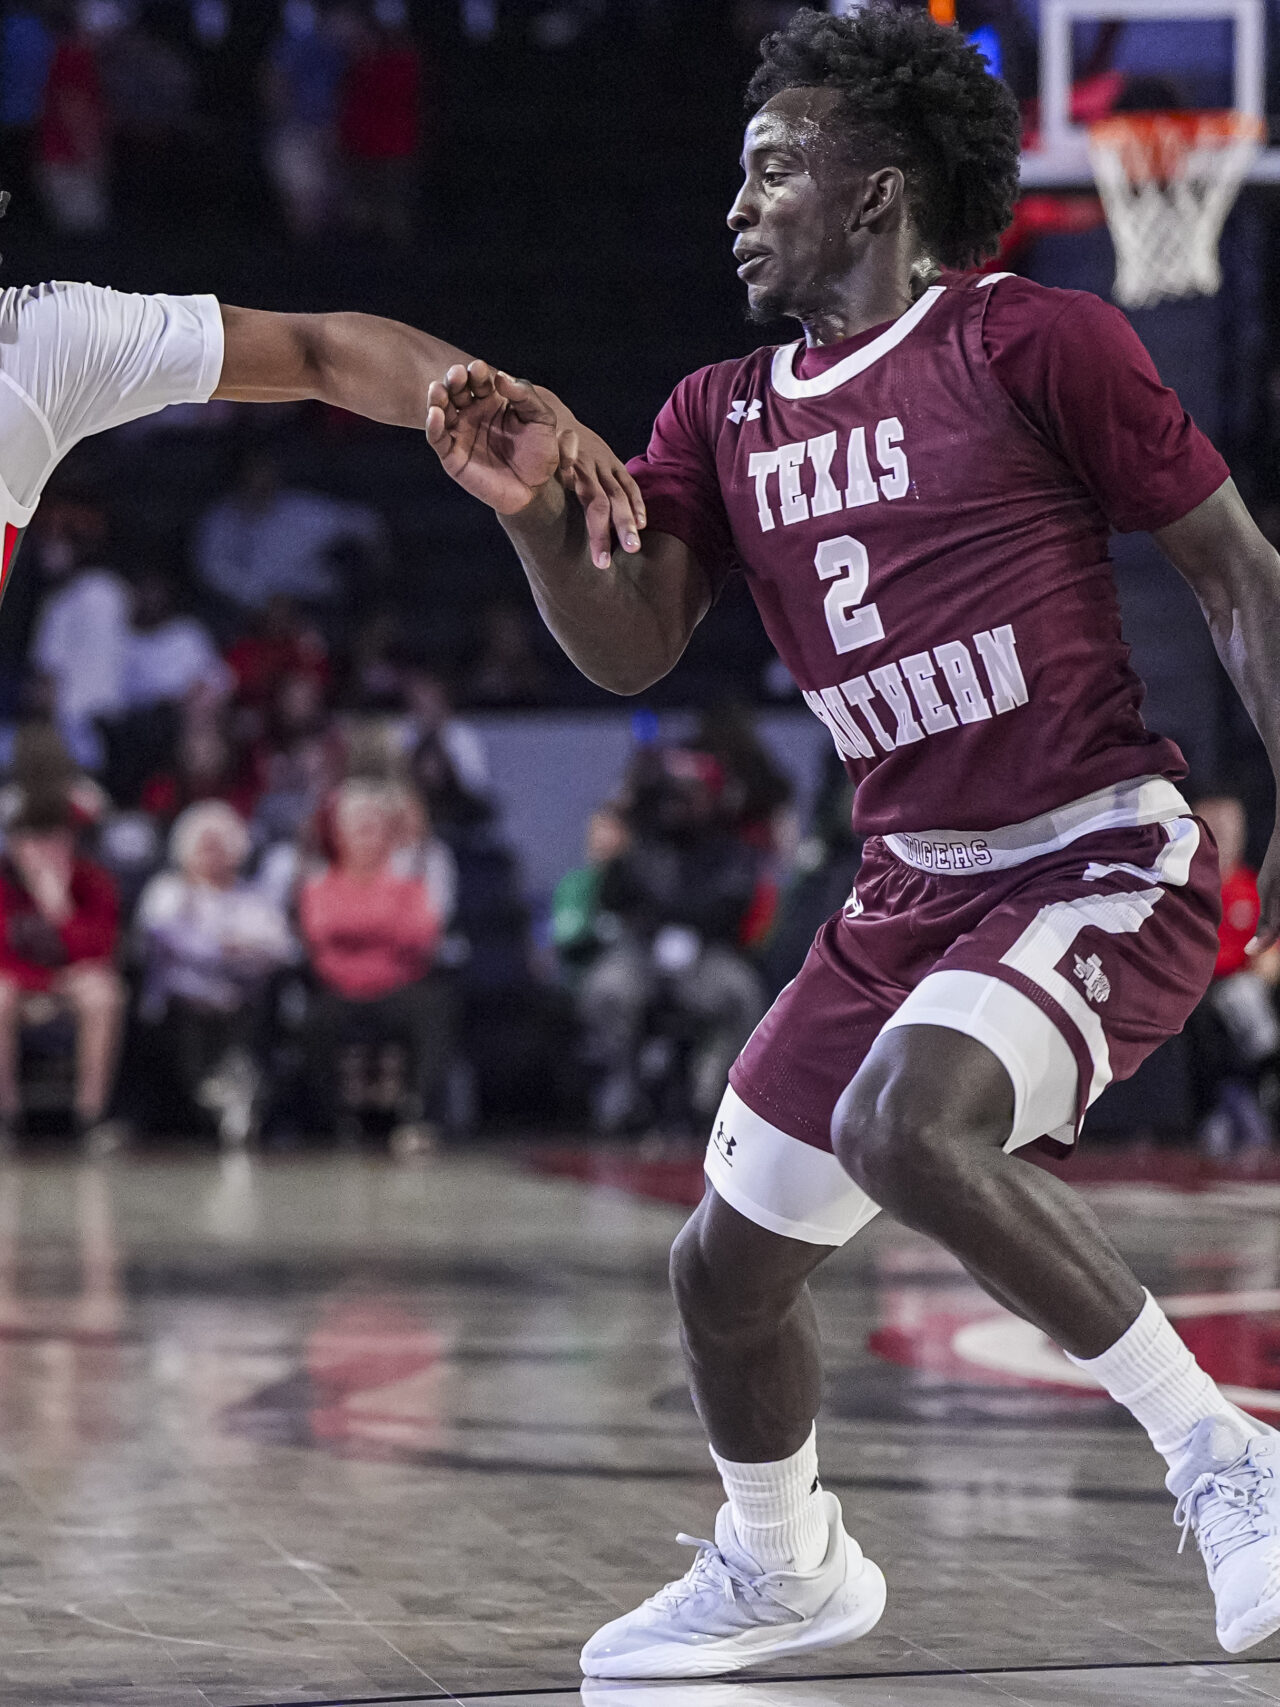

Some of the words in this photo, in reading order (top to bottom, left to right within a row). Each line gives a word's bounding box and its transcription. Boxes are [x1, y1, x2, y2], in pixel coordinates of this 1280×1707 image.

[747, 417, 910, 532] TEXAS
[813, 535, 886, 655] 2
[903, 832, 993, 870] TIGERS
